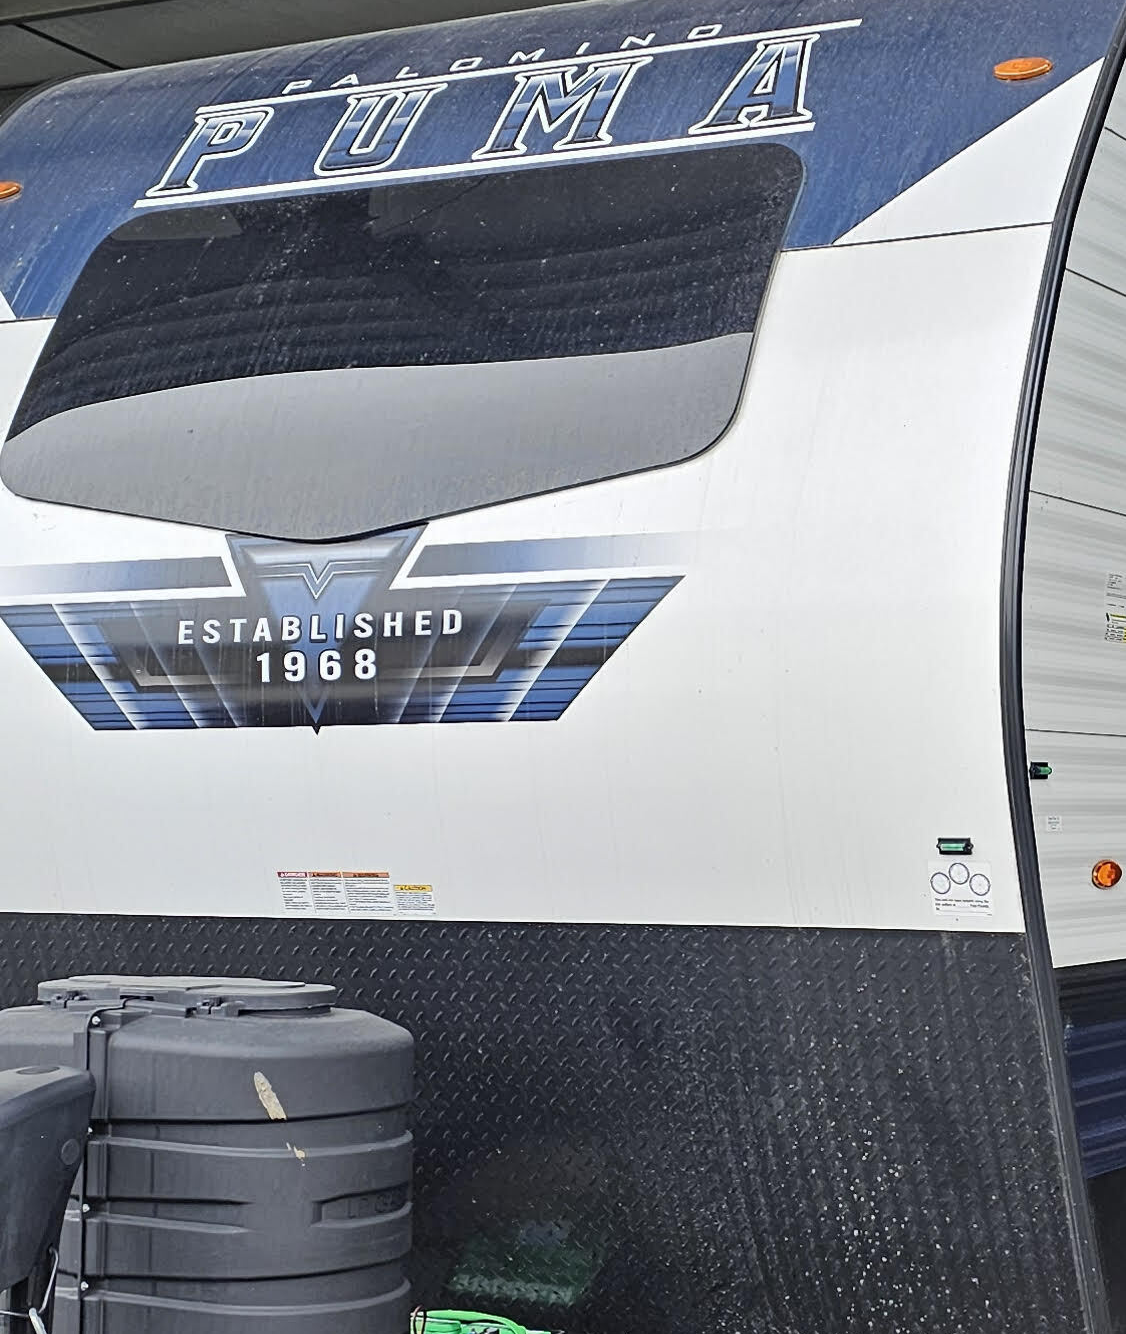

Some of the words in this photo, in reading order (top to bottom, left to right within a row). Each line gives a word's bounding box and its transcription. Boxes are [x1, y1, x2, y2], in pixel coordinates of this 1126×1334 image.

[281, 23, 724, 95] PALOMINO
[144, 32, 820, 197] PUMA
[177, 608, 463, 645] ESTABLISHED
[256, 648, 377, 683] 1968
